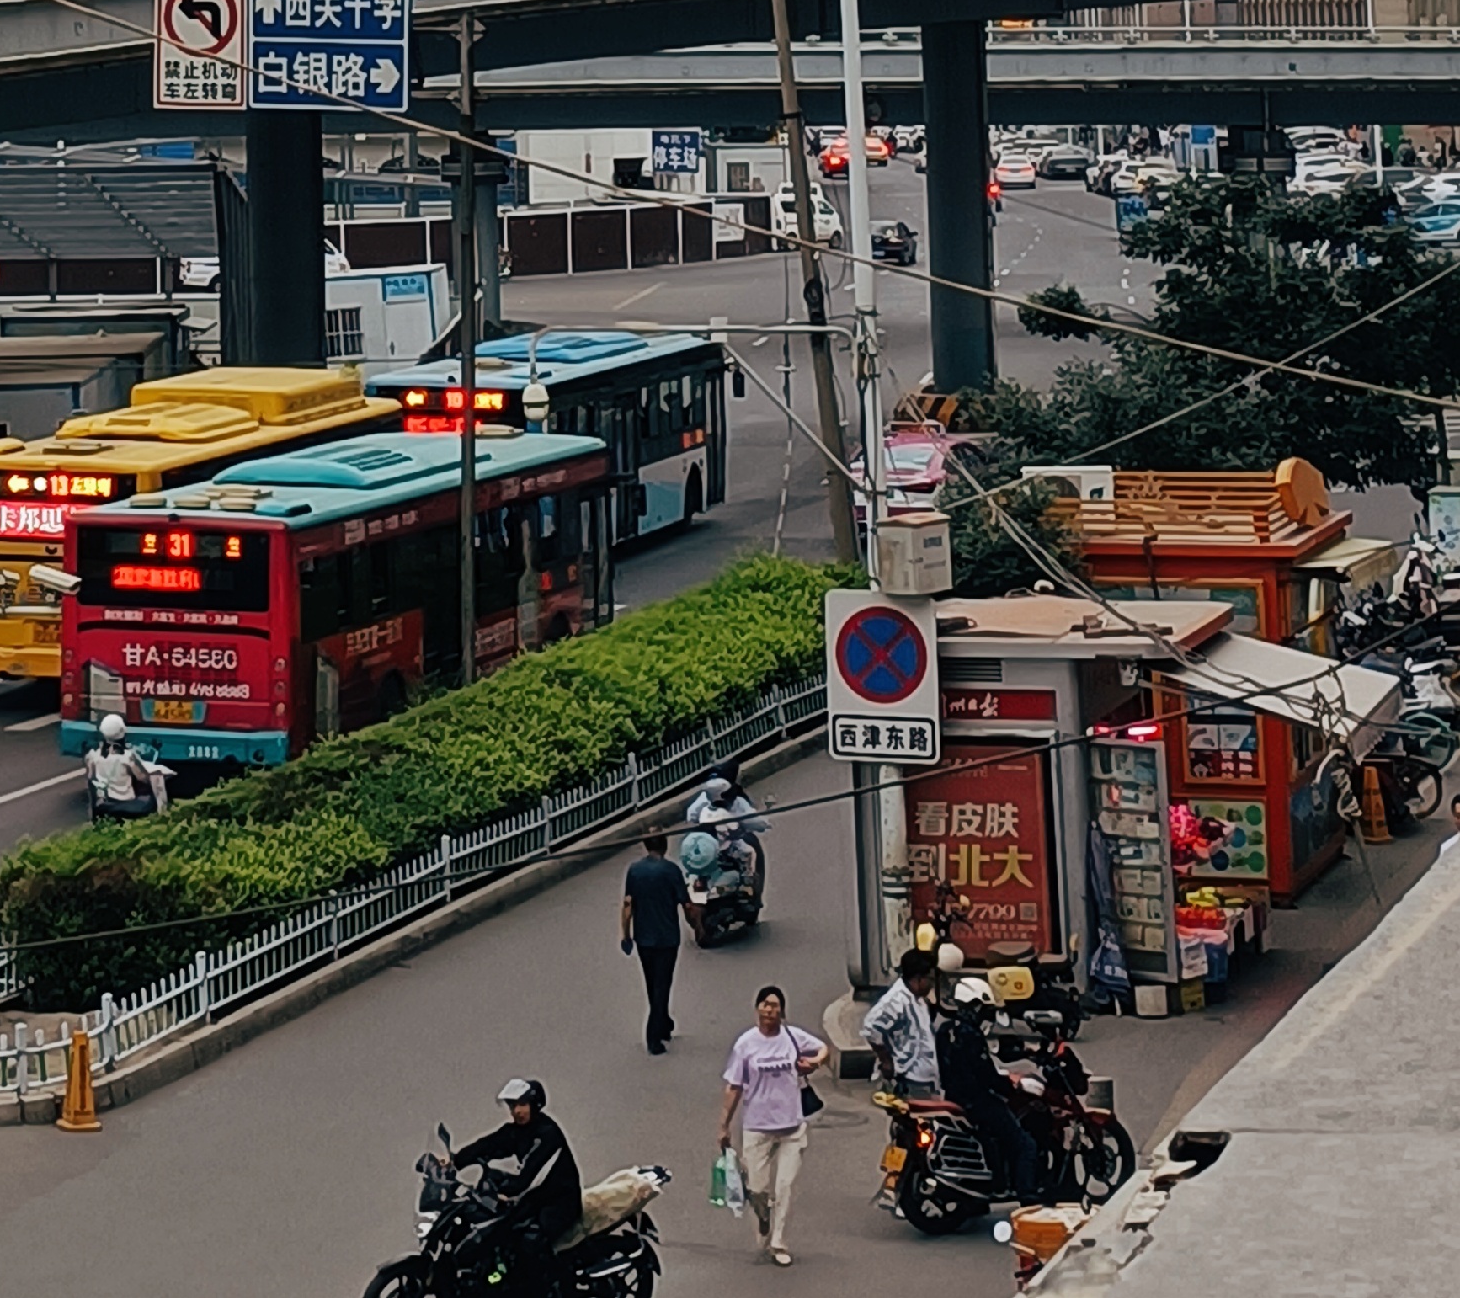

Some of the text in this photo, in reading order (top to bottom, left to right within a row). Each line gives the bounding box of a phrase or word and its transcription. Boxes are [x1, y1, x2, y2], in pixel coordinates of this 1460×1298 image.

[164, 60, 238, 81] 禁止机动
[257, 50, 368, 97] 白银路
[163, 82, 238, 102] 车左转弯
[169, 534, 191, 557] 31
[839, 723, 928, 752] 西津东路
[914, 801, 1020, 838] 看皮肤
[908, 843, 1035, 888] 到北大
